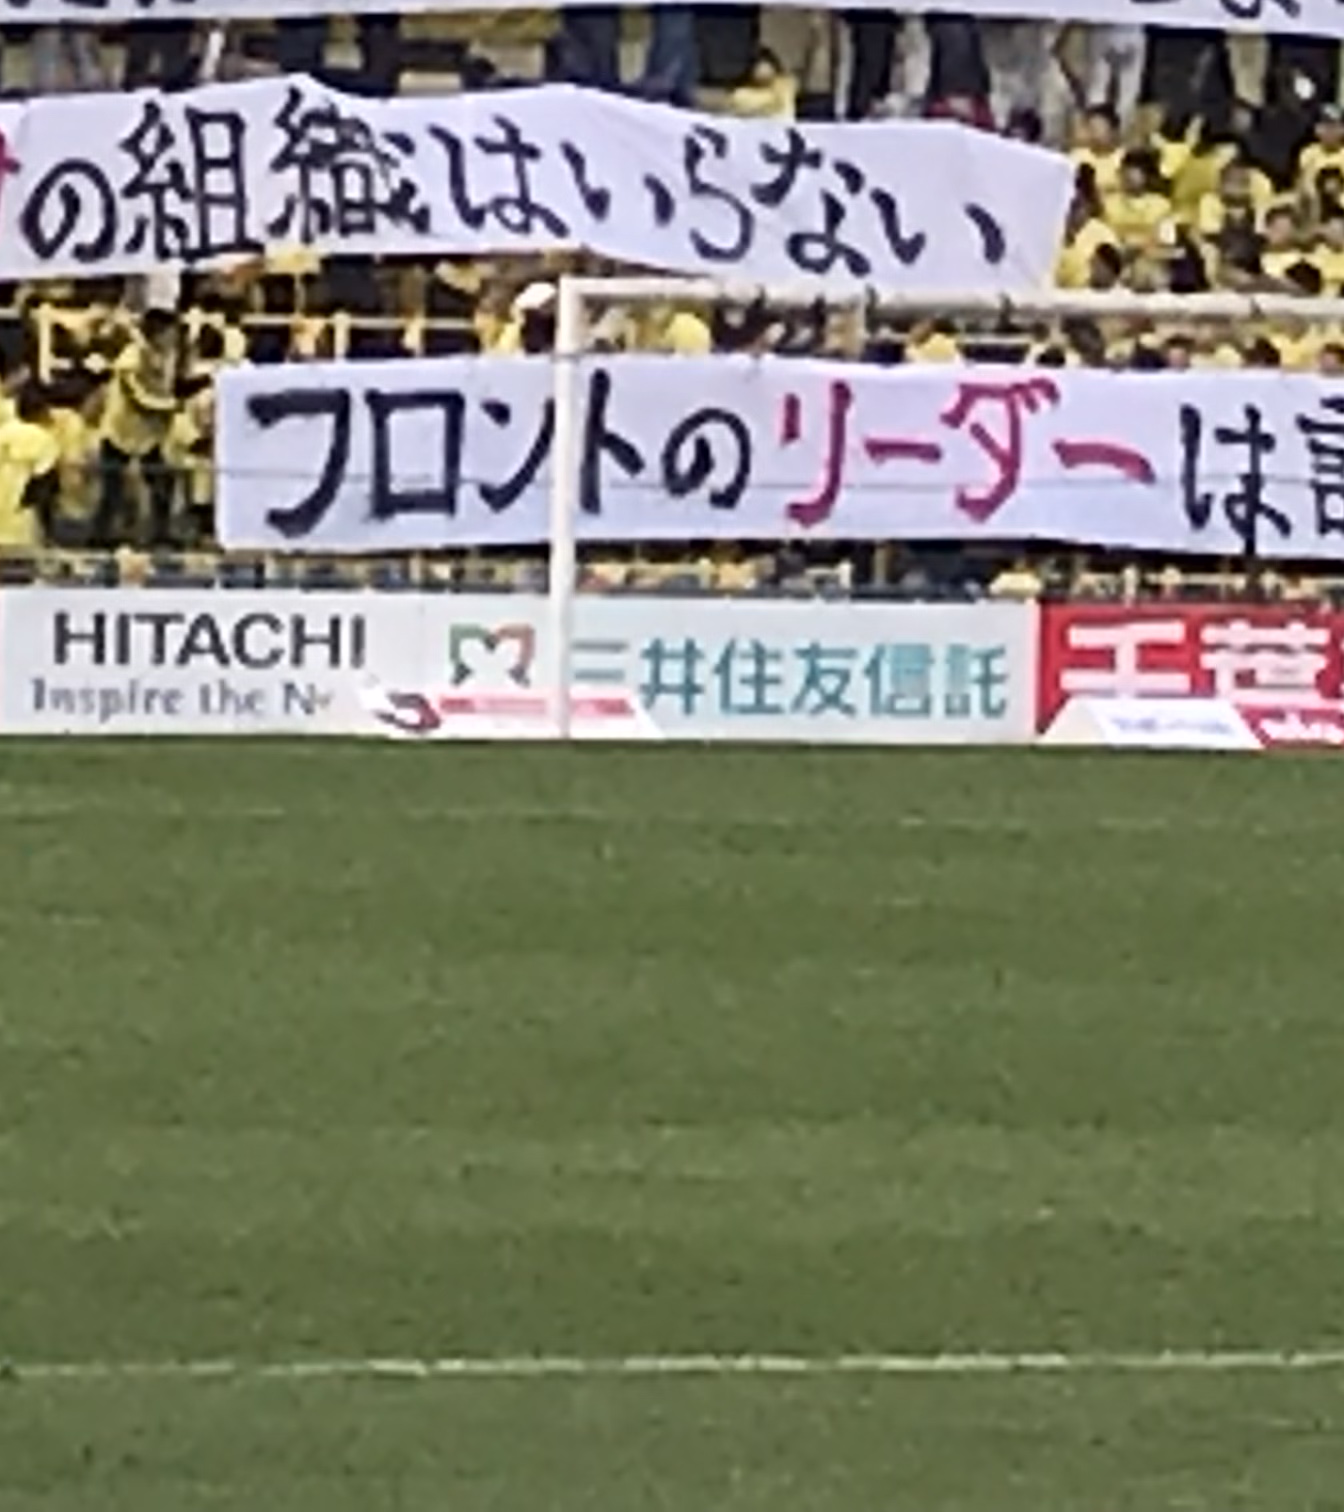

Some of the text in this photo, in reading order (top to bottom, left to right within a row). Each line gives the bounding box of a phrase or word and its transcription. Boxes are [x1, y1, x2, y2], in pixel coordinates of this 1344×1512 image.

[53, 611, 366, 670] HITACHI
[31, 677, 183, 724] Inspire
[197, 678, 266, 718] the
[569, 638, 1009, 720] 三井住友信託
